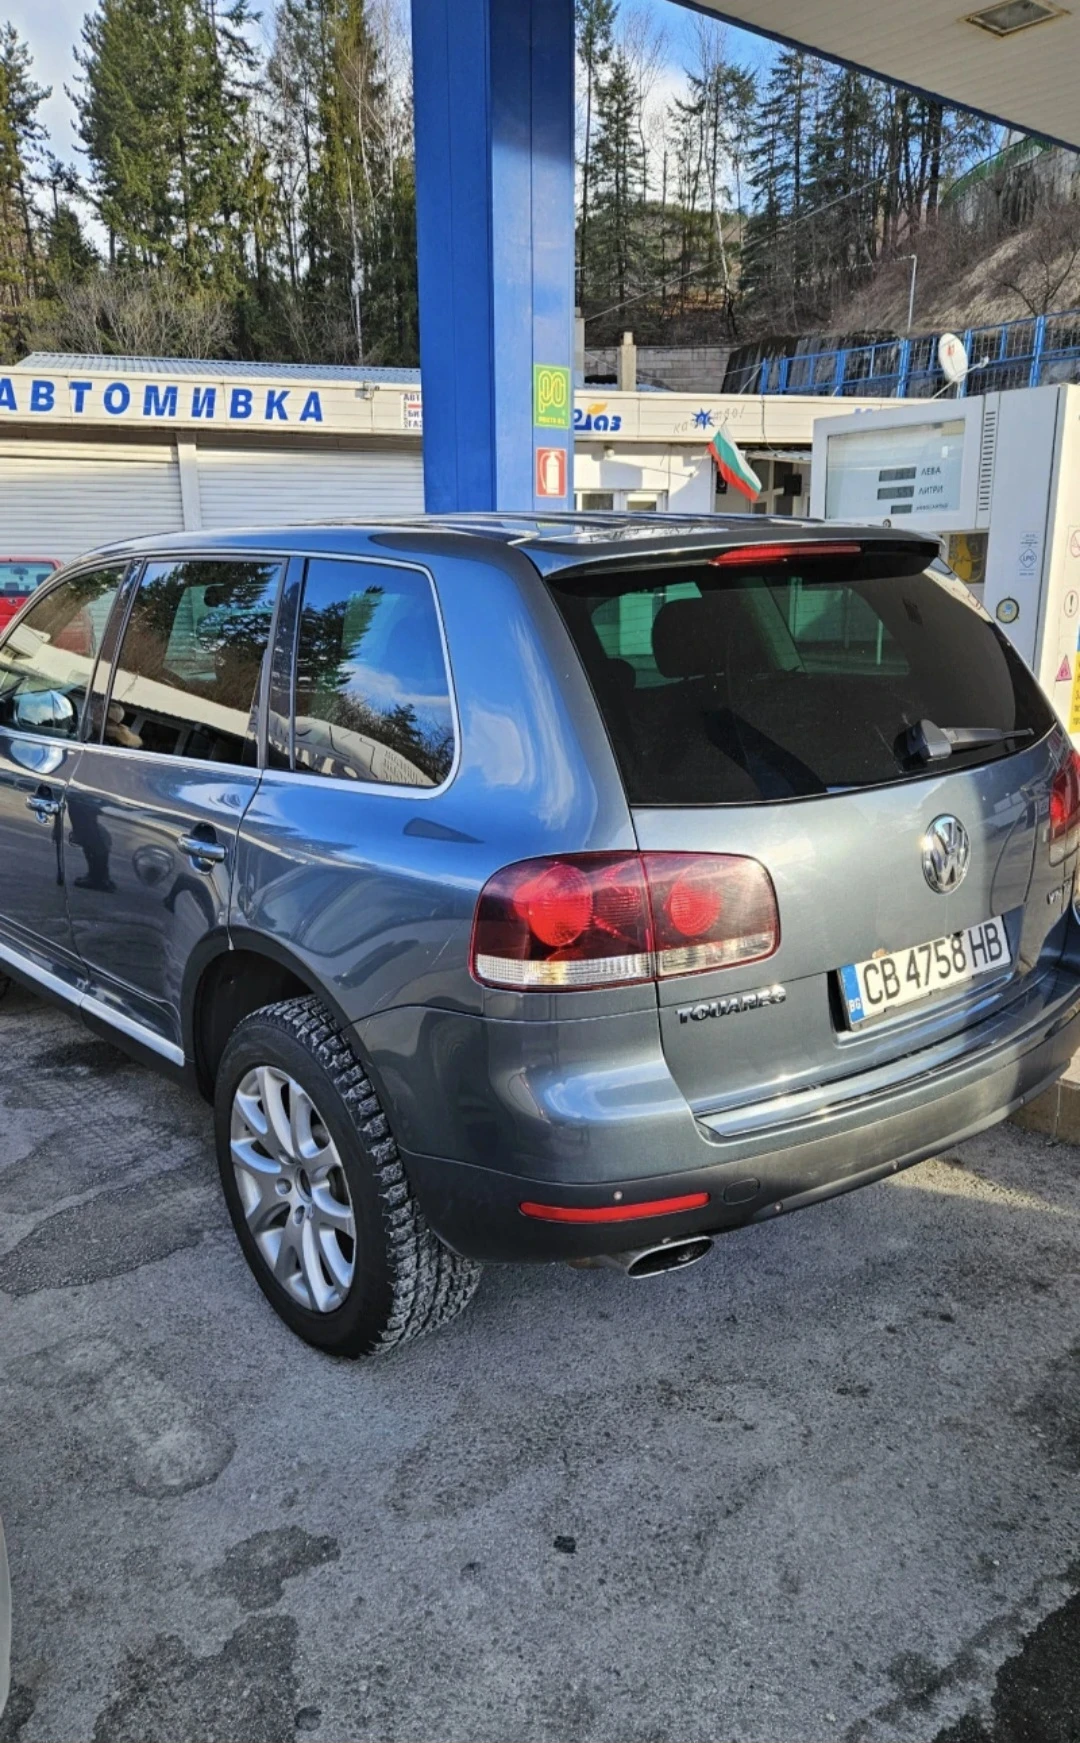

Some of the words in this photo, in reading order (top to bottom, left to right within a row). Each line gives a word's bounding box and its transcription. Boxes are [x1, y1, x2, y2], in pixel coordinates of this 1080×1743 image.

[0, 378, 324, 422] АВТОМИВКА
[921, 466, 941, 476] ЛЕВА
[918, 485, 943, 495] ЛИТРИ
[863, 957, 900, 1005] CB
[906, 936, 967, 989] 4758
[968, 922, 1003, 968] HB
